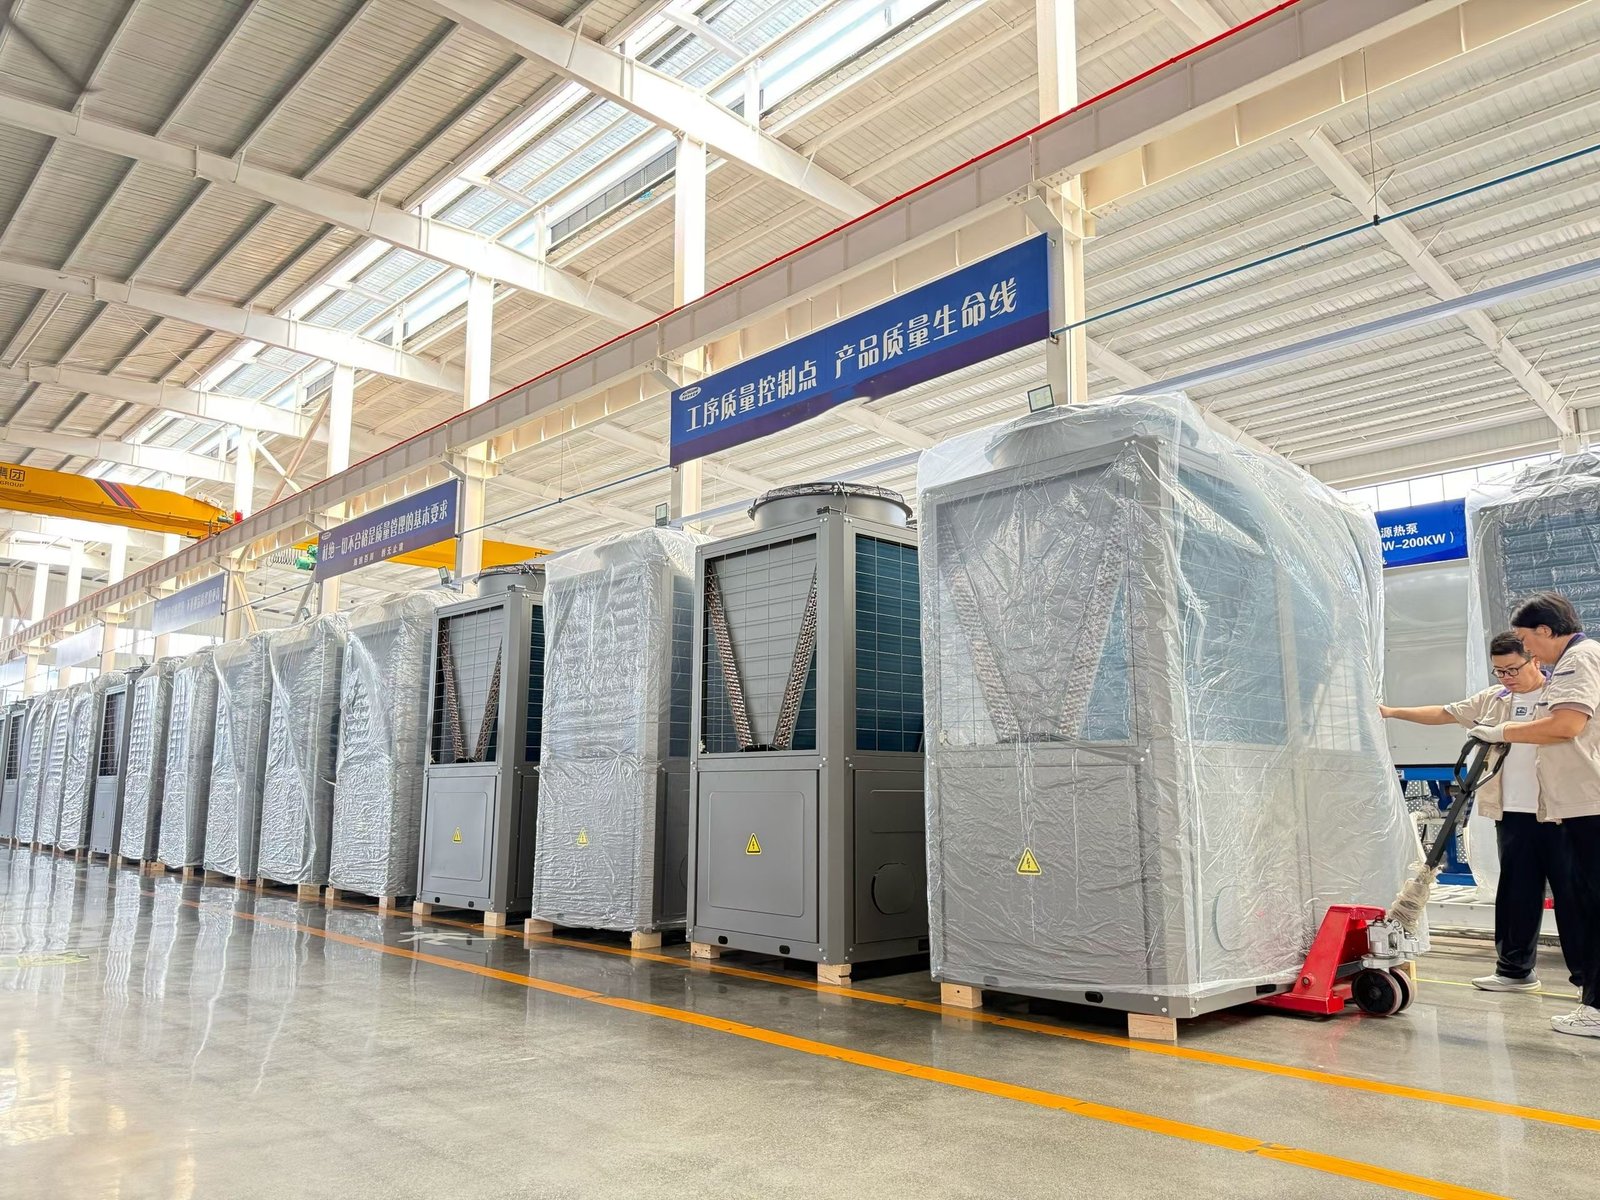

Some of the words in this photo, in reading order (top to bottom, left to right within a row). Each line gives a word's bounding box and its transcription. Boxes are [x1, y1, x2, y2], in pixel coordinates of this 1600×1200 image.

[686, 360, 817, 432] 工序质量控制点
[835, 277, 1018, 379] 产品质量生命线
[1381, 523, 1418, 538] 源热泵
